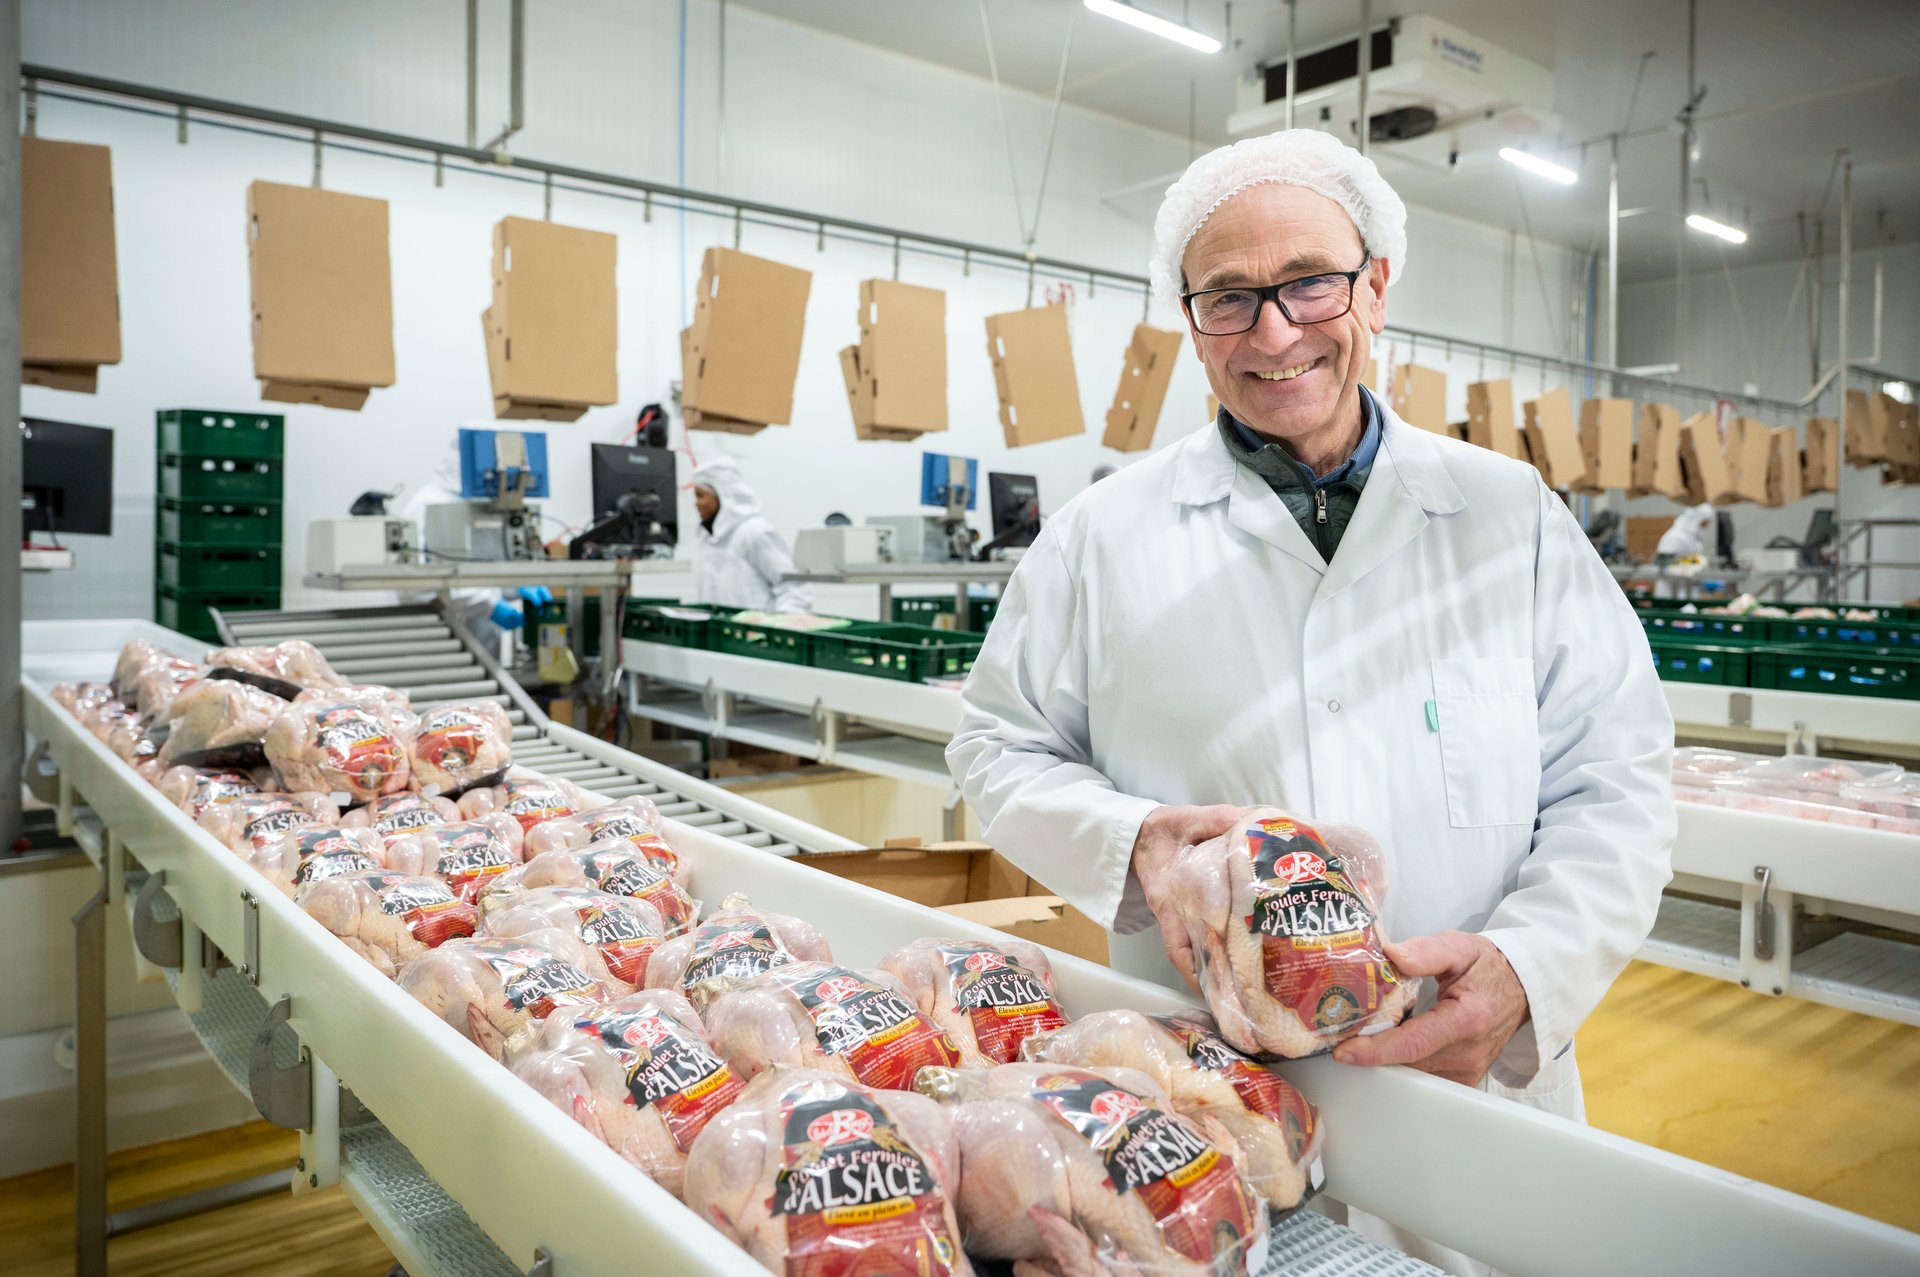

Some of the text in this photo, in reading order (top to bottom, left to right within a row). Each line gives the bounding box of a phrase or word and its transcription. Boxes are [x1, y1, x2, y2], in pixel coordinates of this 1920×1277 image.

[1261, 900, 1370, 936] d'ALSAC
[1264, 889, 1361, 915] Poulet Fermier
[693, 953, 730, 978] Poulet
[964, 975, 1000, 1003] Poulet
[636, 1050, 676, 1086] Poulet
[850, 1150, 920, 1169] Fermier
[1115, 1123, 1154, 1170] Poulet
[1125, 1124, 1207, 1185] d'ALSAC
[783, 1162, 924, 1215] d'ALSACE
